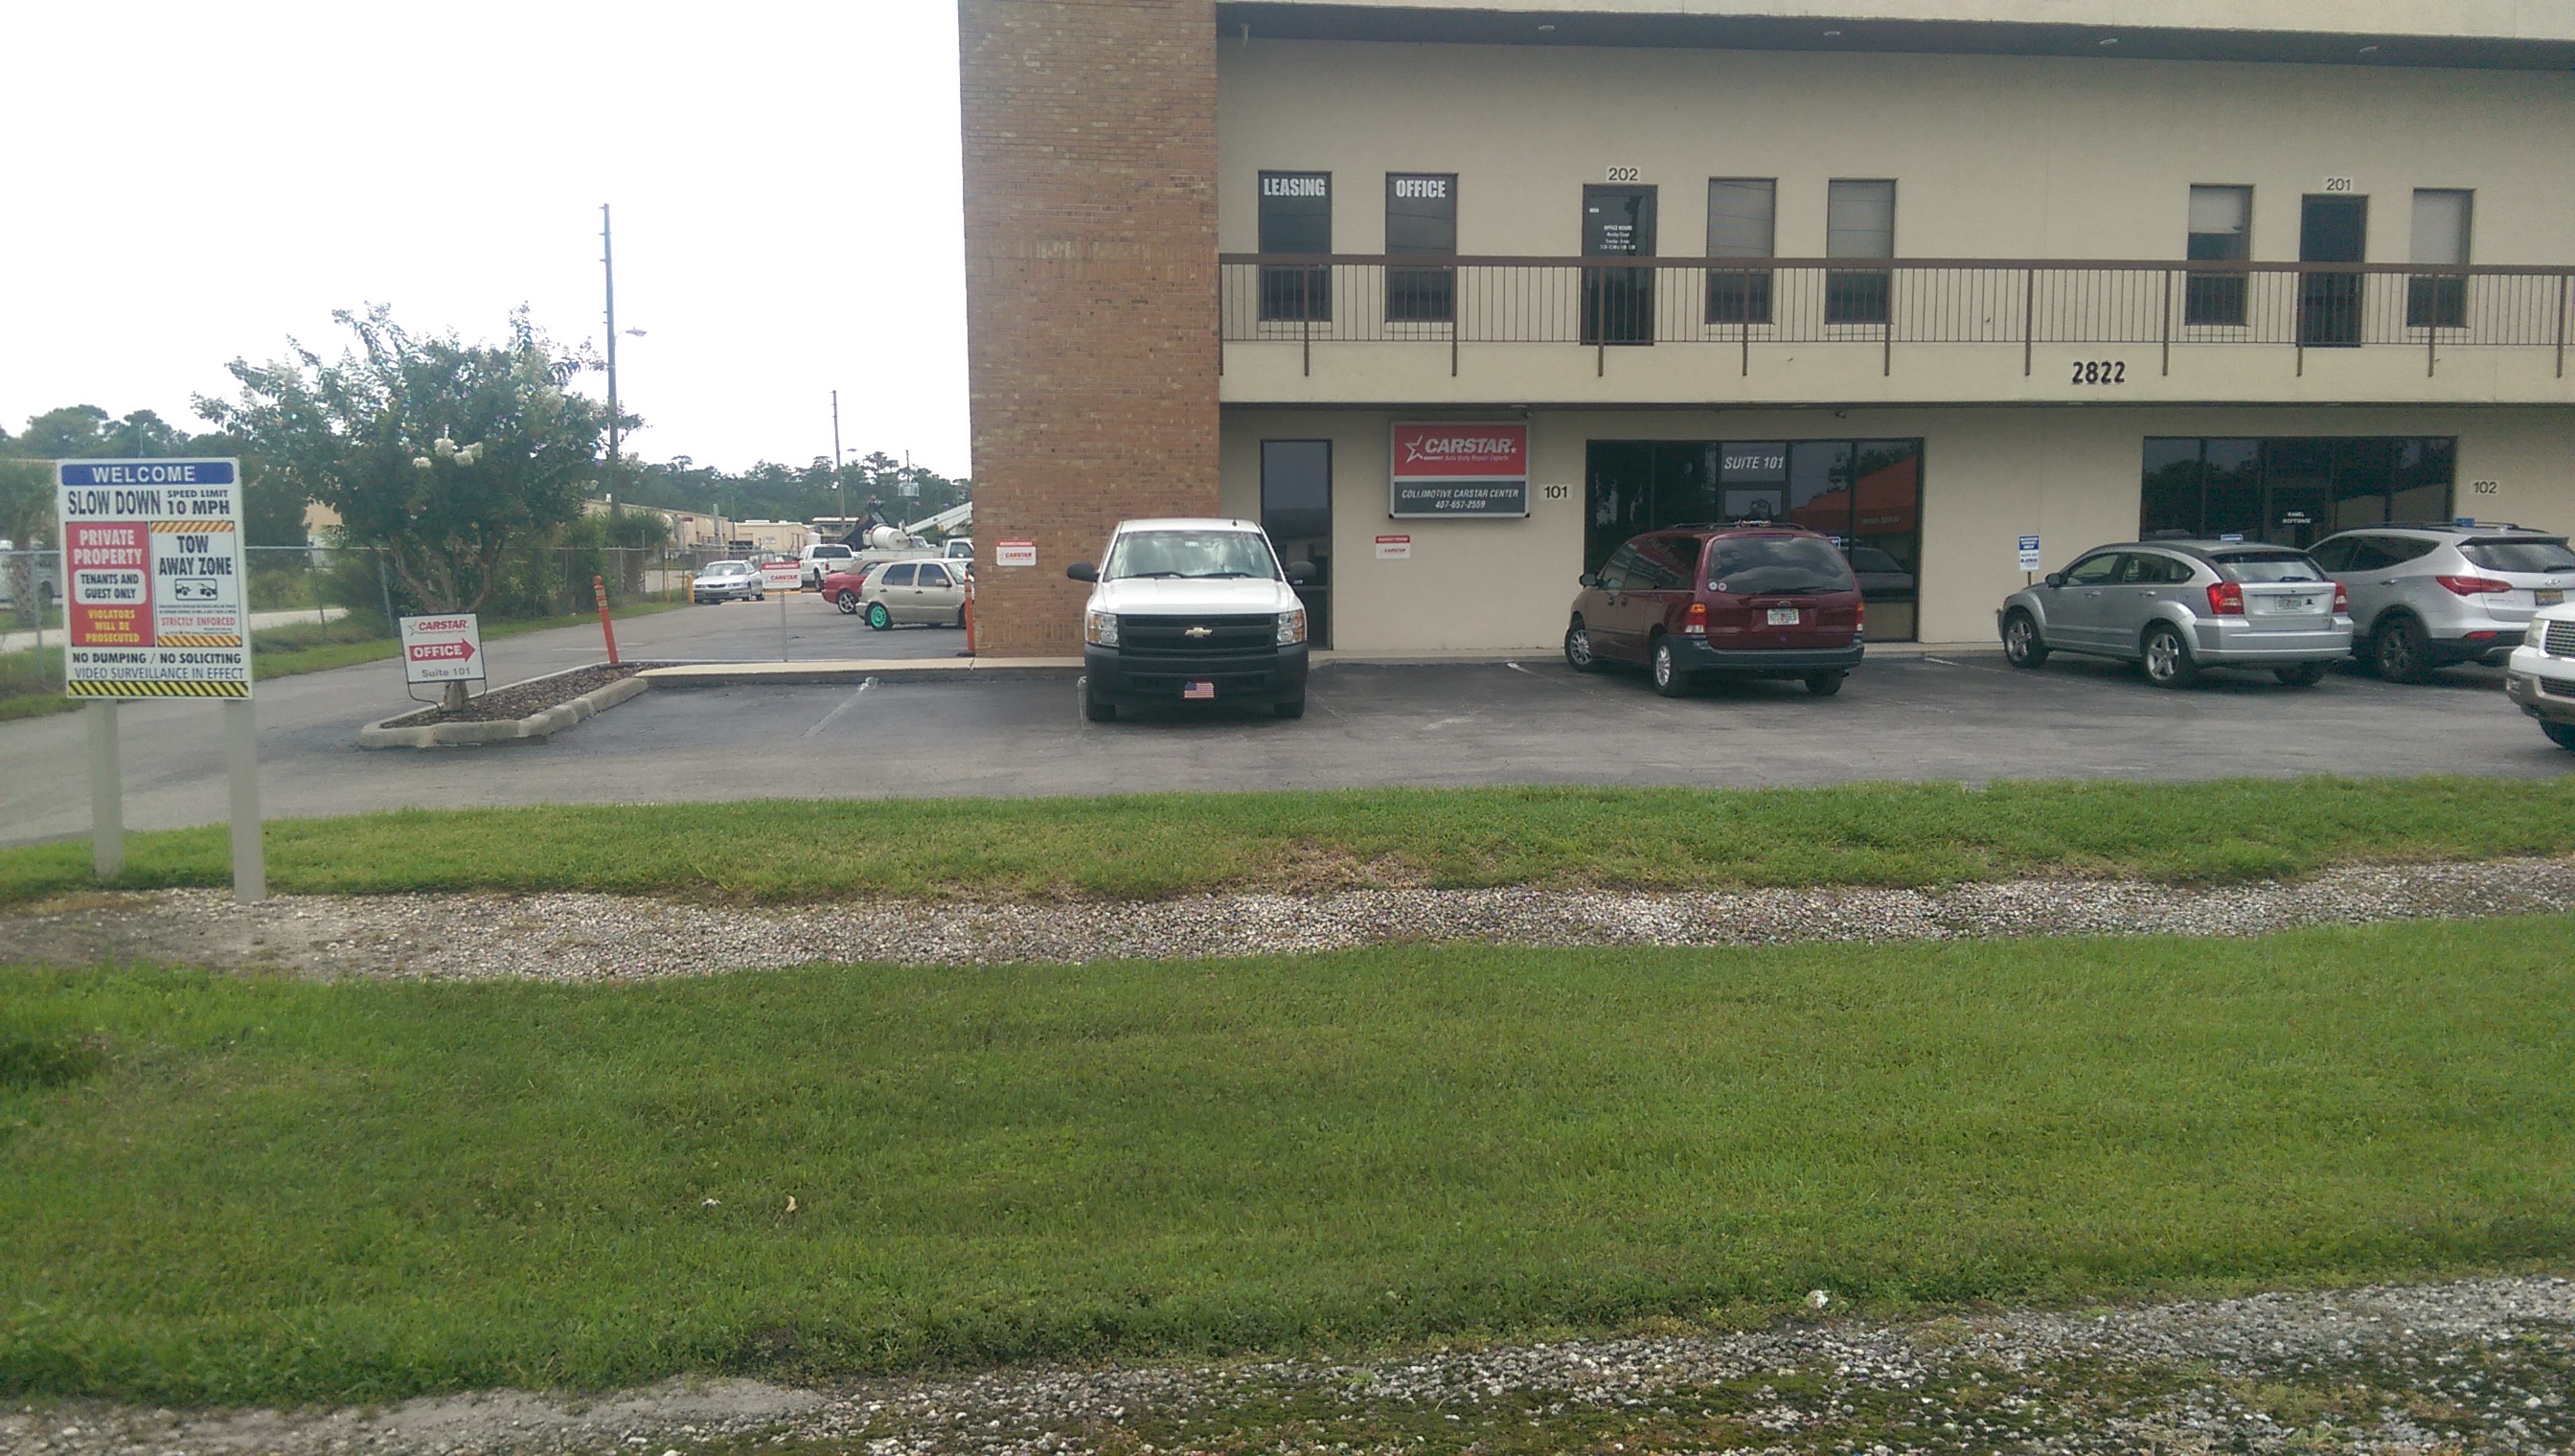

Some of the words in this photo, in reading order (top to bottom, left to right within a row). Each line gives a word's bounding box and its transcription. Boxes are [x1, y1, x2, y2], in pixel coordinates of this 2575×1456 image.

[1608, 167, 1638, 182] 202
[1264, 178, 1326, 196] LEASING
[1396, 179, 1446, 197] OFFICE
[2326, 178, 2351, 192] 201
[2071, 361, 2126, 384] 2822
[1424, 438, 1511, 454] CARSTAR
[1724, 456, 1760, 469] SUITE
[1764, 456, 1785, 469] 101
[92, 466, 195, 483] WELCOME
[200, 489, 229, 498] LIMIT
[1454, 489, 1488, 498] CARSTAR
[1490, 489, 1519, 498] CENTER
[1543, 486, 1568, 498] 101
[2473, 481, 2497, 494] 102
[68, 490, 110, 515] SLOW
[116, 490, 161, 515] DOWN
[168, 500, 186, 515] 10
[192, 500, 230, 515] MPH
[80, 529, 135, 546] PRIVATE
[176, 535, 209, 554] TOW
[74, 548, 143, 565] PROPERTY
[159, 557, 194, 576] AWAY
[198, 557, 232, 575] ZONE
[80, 575, 119, 584] TENANTS
[121, 574, 139, 584] AND
[84, 588, 112, 600] GUEST
[115, 588, 136, 599] ONLY
[87, 609, 136, 620] VIOLATORS
[94, 621, 117, 631] WILL
[119, 621, 130, 631] BE
[161, 617, 194, 626] STRICTLY
[196, 617, 236, 626] ENFORCED
[419, 620, 467, 630] CARSTAR
[85, 633, 140, 644] PROSECUTED
[413, 645, 463, 658] OFFICE
[73, 653, 88, 664] NO
[92, 653, 147, 665] DUMPING
[160, 653, 176, 664] NO
[179, 653, 241, 665] SOLICITING
[75, 668, 107, 680] VIDEO
[111, 668, 188, 680] SURVEILLANCE
[192, 668, 204, 679] IN
[207, 667, 244, 679] EFFECT
[422, 669, 449, 678] Suite
[453, 667, 471, 676] 101
